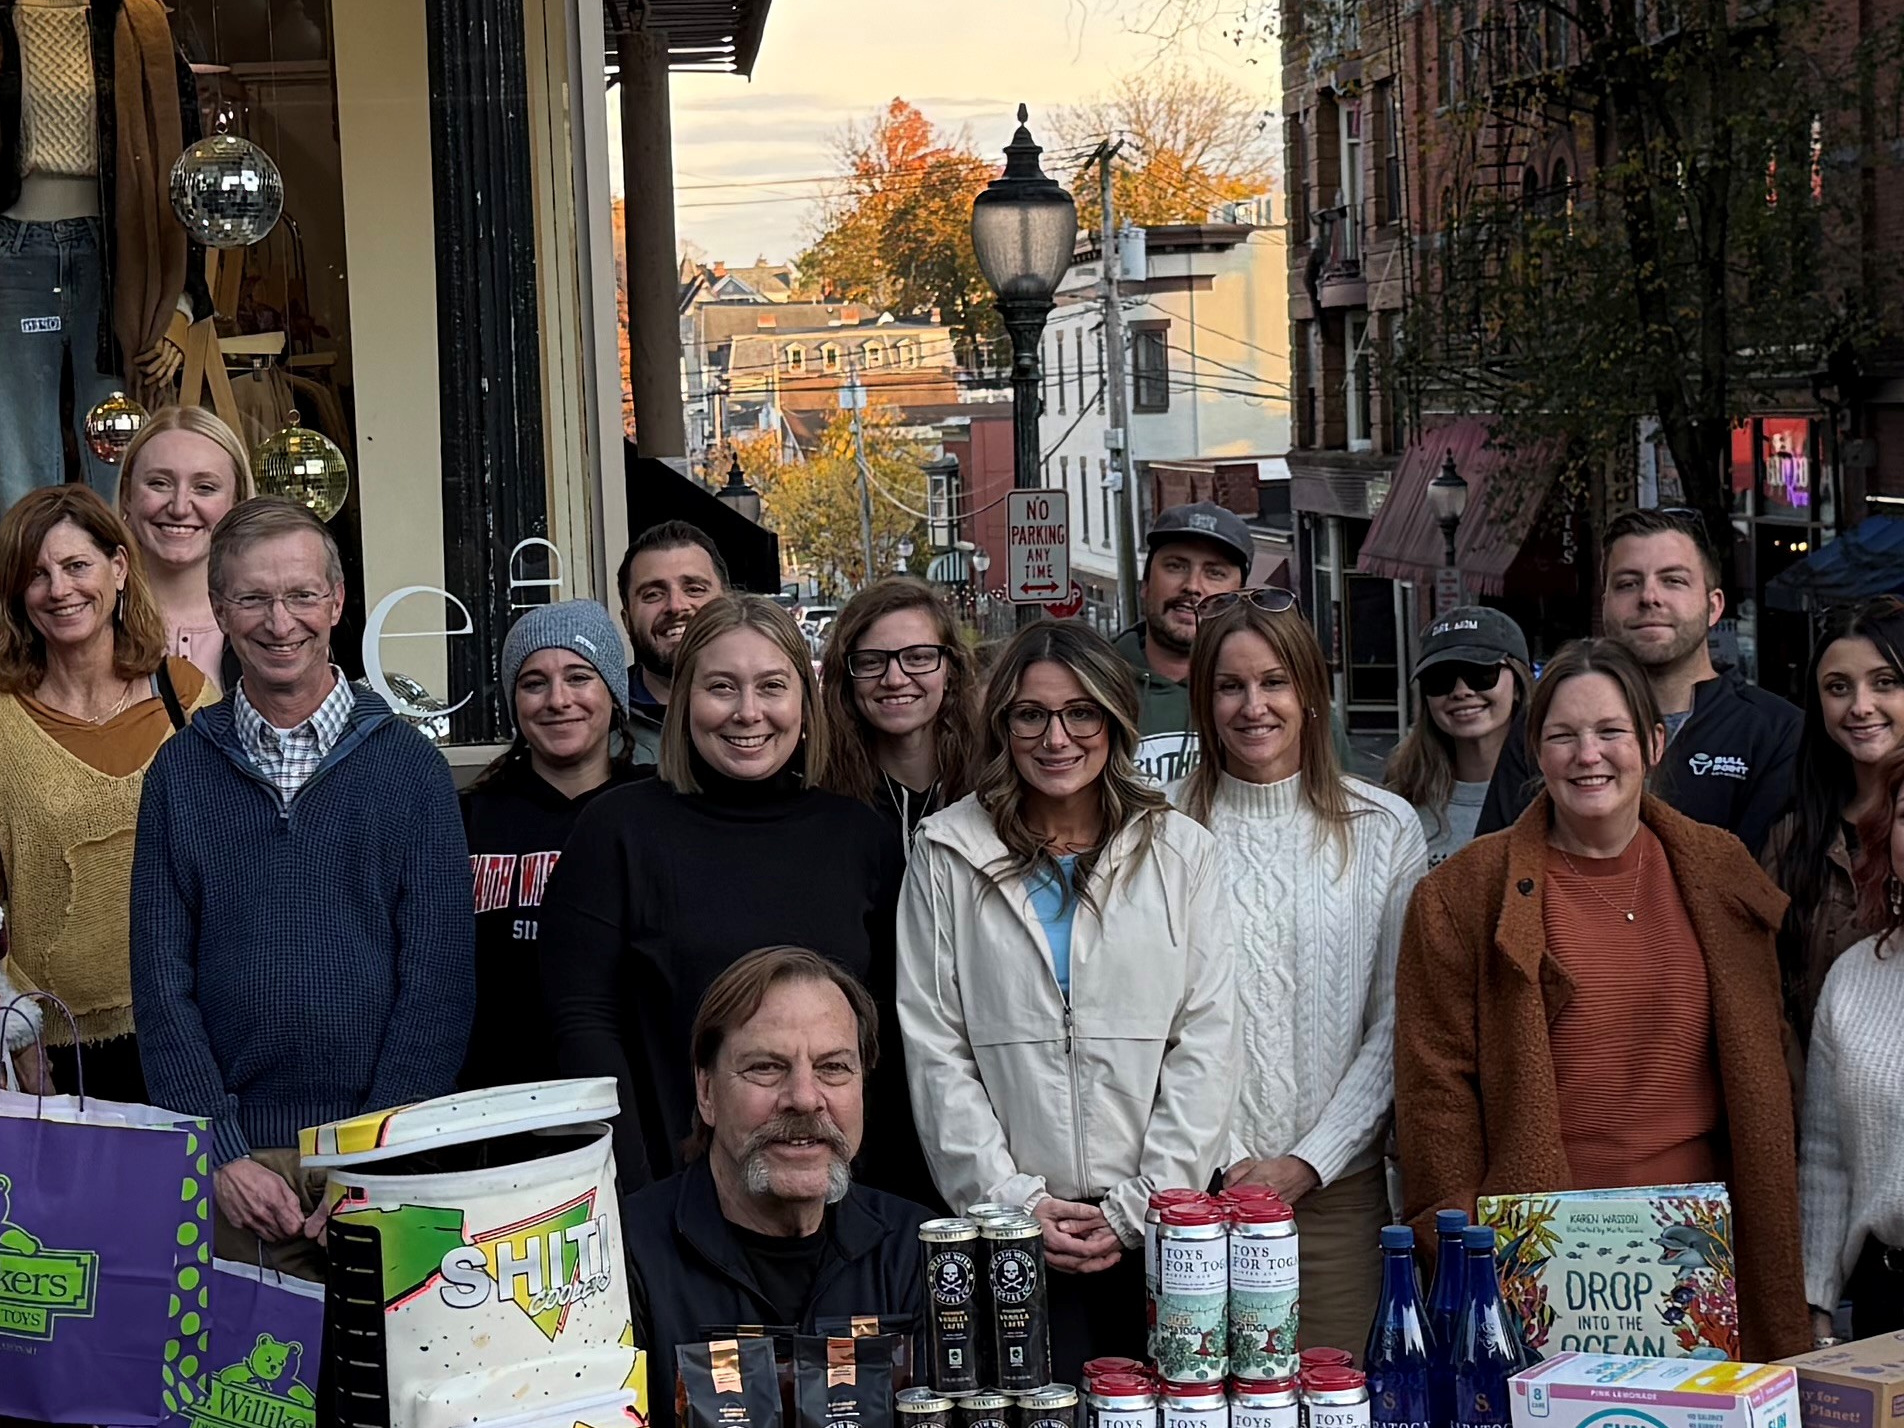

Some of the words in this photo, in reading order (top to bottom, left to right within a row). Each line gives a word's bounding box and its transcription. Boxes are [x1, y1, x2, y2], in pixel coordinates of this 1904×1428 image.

[1026, 500, 1049, 520] NO
[1011, 524, 1065, 546] PARKING
[1027, 548, 1050, 562] ANY
[1025, 564, 1053, 579] TIME
[1565, 1270, 1652, 1312] DROP
[0, 1306, 43, 1329] TOYS
[1578, 1316, 1609, 1330] INTO
[1617, 1316, 1643, 1331] THE
